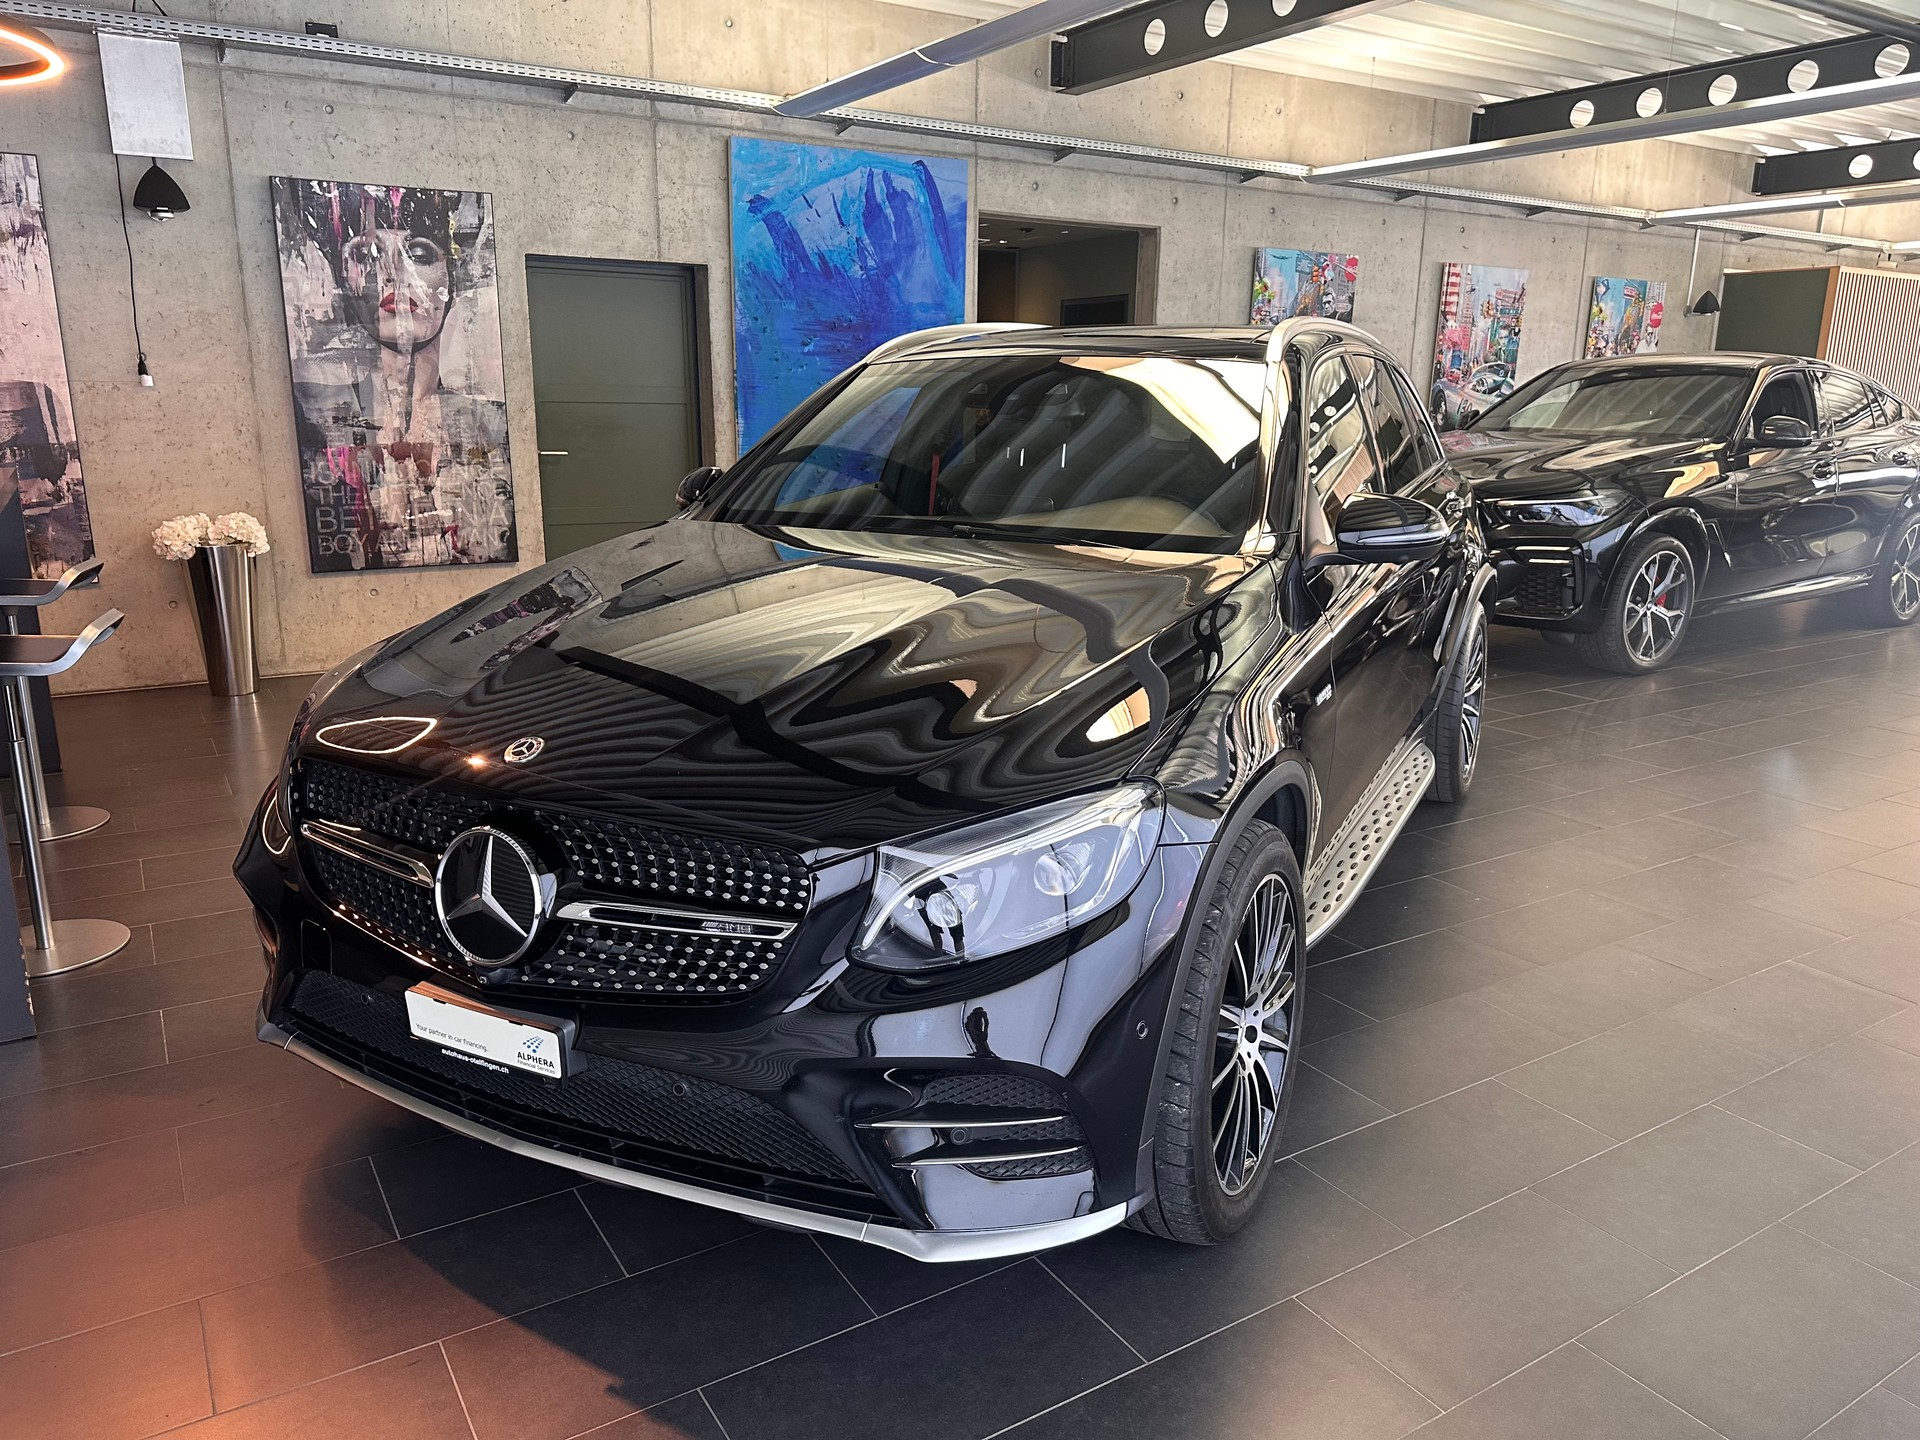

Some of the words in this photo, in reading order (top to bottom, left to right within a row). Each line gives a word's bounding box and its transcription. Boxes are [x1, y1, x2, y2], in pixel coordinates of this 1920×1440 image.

[318, 533, 368, 555] BOY
[415, 1023, 428, 1032] Your
[428, 1027, 447, 1038] partner
[454, 1036, 463, 1044] car
[517, 1051, 555, 1069] ALPHERA
[517, 1058, 537, 1069] Financial
[536, 1064, 556, 1075] Services
